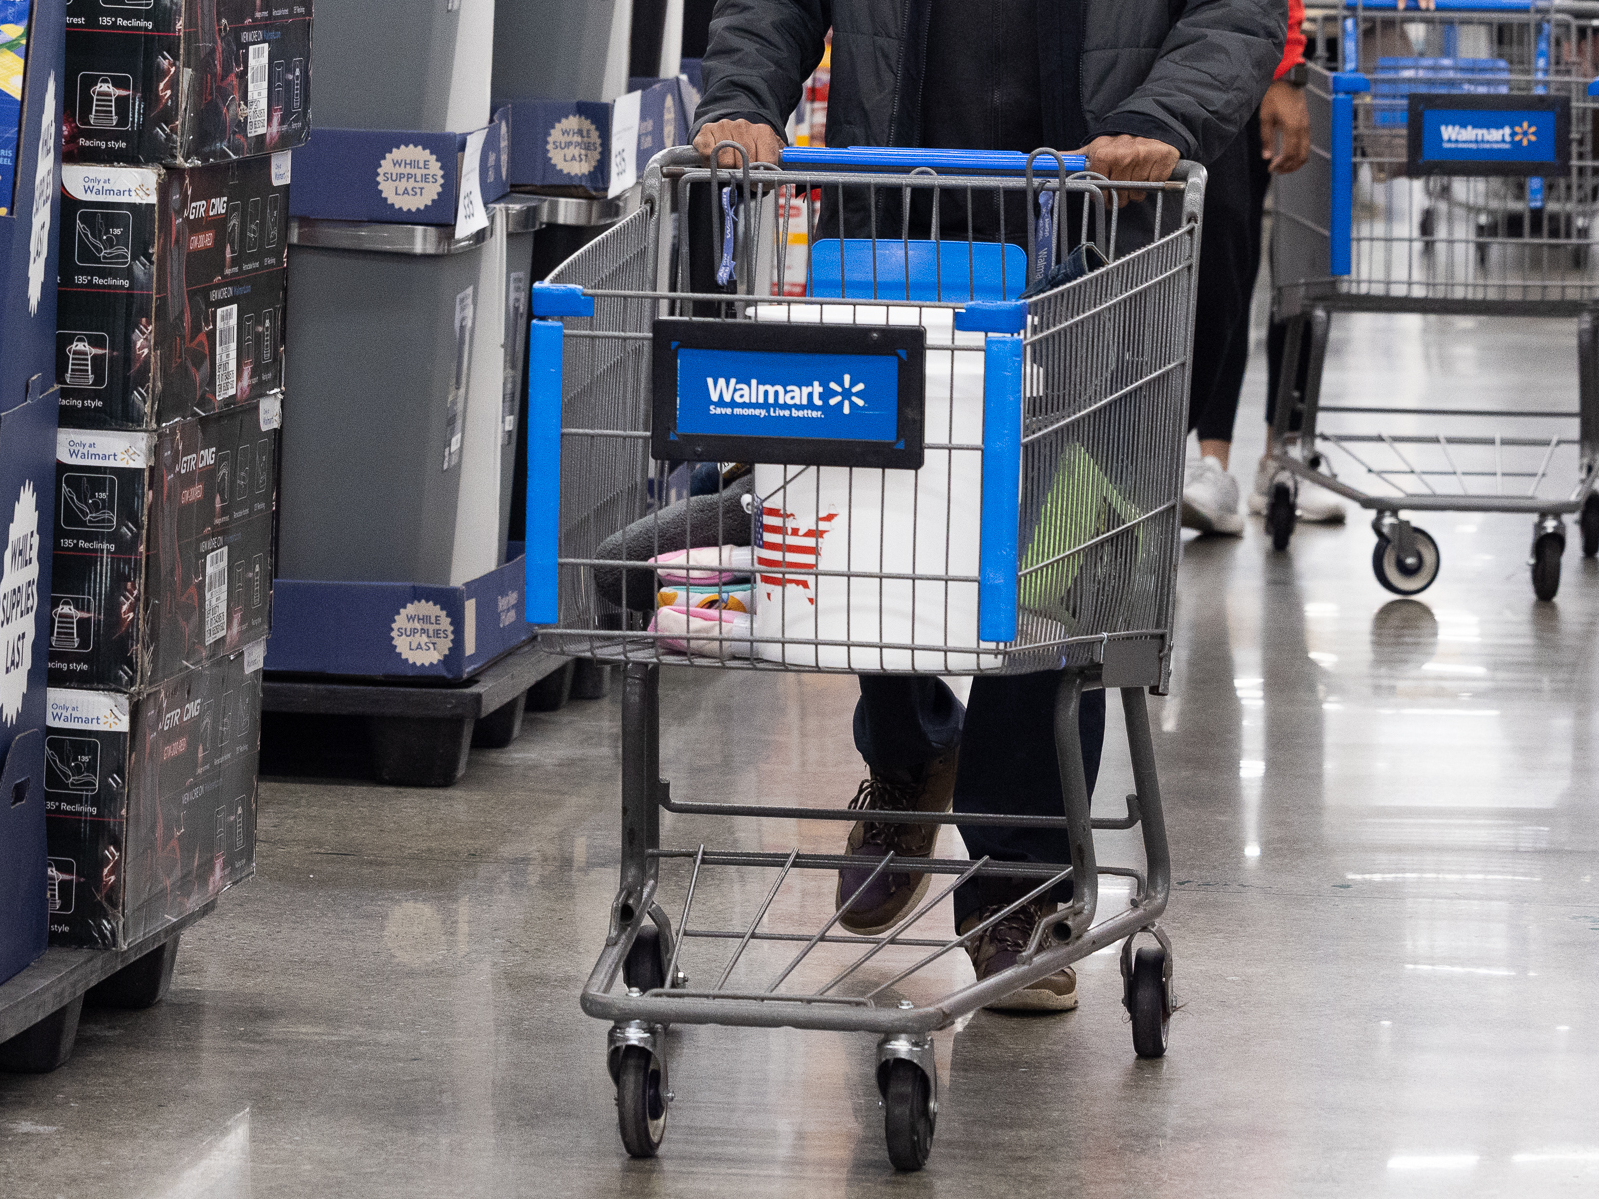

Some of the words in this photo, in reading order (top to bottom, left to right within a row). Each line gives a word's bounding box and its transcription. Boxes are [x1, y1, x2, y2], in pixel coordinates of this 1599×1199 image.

[99, 17, 115, 25] 135°
[117, 17, 153, 29] Reclining
[561, 128, 591, 139] WHILE
[1440, 124, 1512, 142] Walmart
[79, 138, 105, 148] Racing
[107, 139, 126, 149] style
[552, 140, 597, 152] SUPPLIES
[392, 159, 430, 169] WHILE
[563, 153, 589, 164] LAST
[83, 176, 101, 185] Only
[103, 177, 111, 185] at
[383, 172, 438, 184] SUPPLIES
[83, 185, 132, 197] Walmart
[395, 186, 425, 196] LAST
[75, 276, 91, 284] 135°
[93, 277, 129, 287] Reclining
[706, 377, 823, 406] Walmart
[84, 399, 103, 408] style
[709, 405, 732, 415] Save
[733, 408, 768, 419] money.
[770, 407, 790, 417] Live
[792, 408, 825, 418] better.
[68, 440, 86, 449] Only
[88, 441, 96, 449] at
[68, 449, 118, 461] Walmart
[61, 539, 77, 548] 135°
[79, 540, 115, 551] Reclining
[10, 530, 34, 574] WHILE
[1, 578, 35, 628] SUPPLIES
[406, 614, 441, 625] WHILE
[397, 627, 449, 639] SUPPLIES
[409, 641, 437, 651] LAST
[5, 631, 26, 675] LAST
[70, 663, 89, 672] style
[51, 703, 70, 712] Only
[51, 712, 101, 725] Walmart
[45, 802, 59, 810] 35°
[60, 803, 97, 814] Reclining
[51, 925, 70, 933] style
